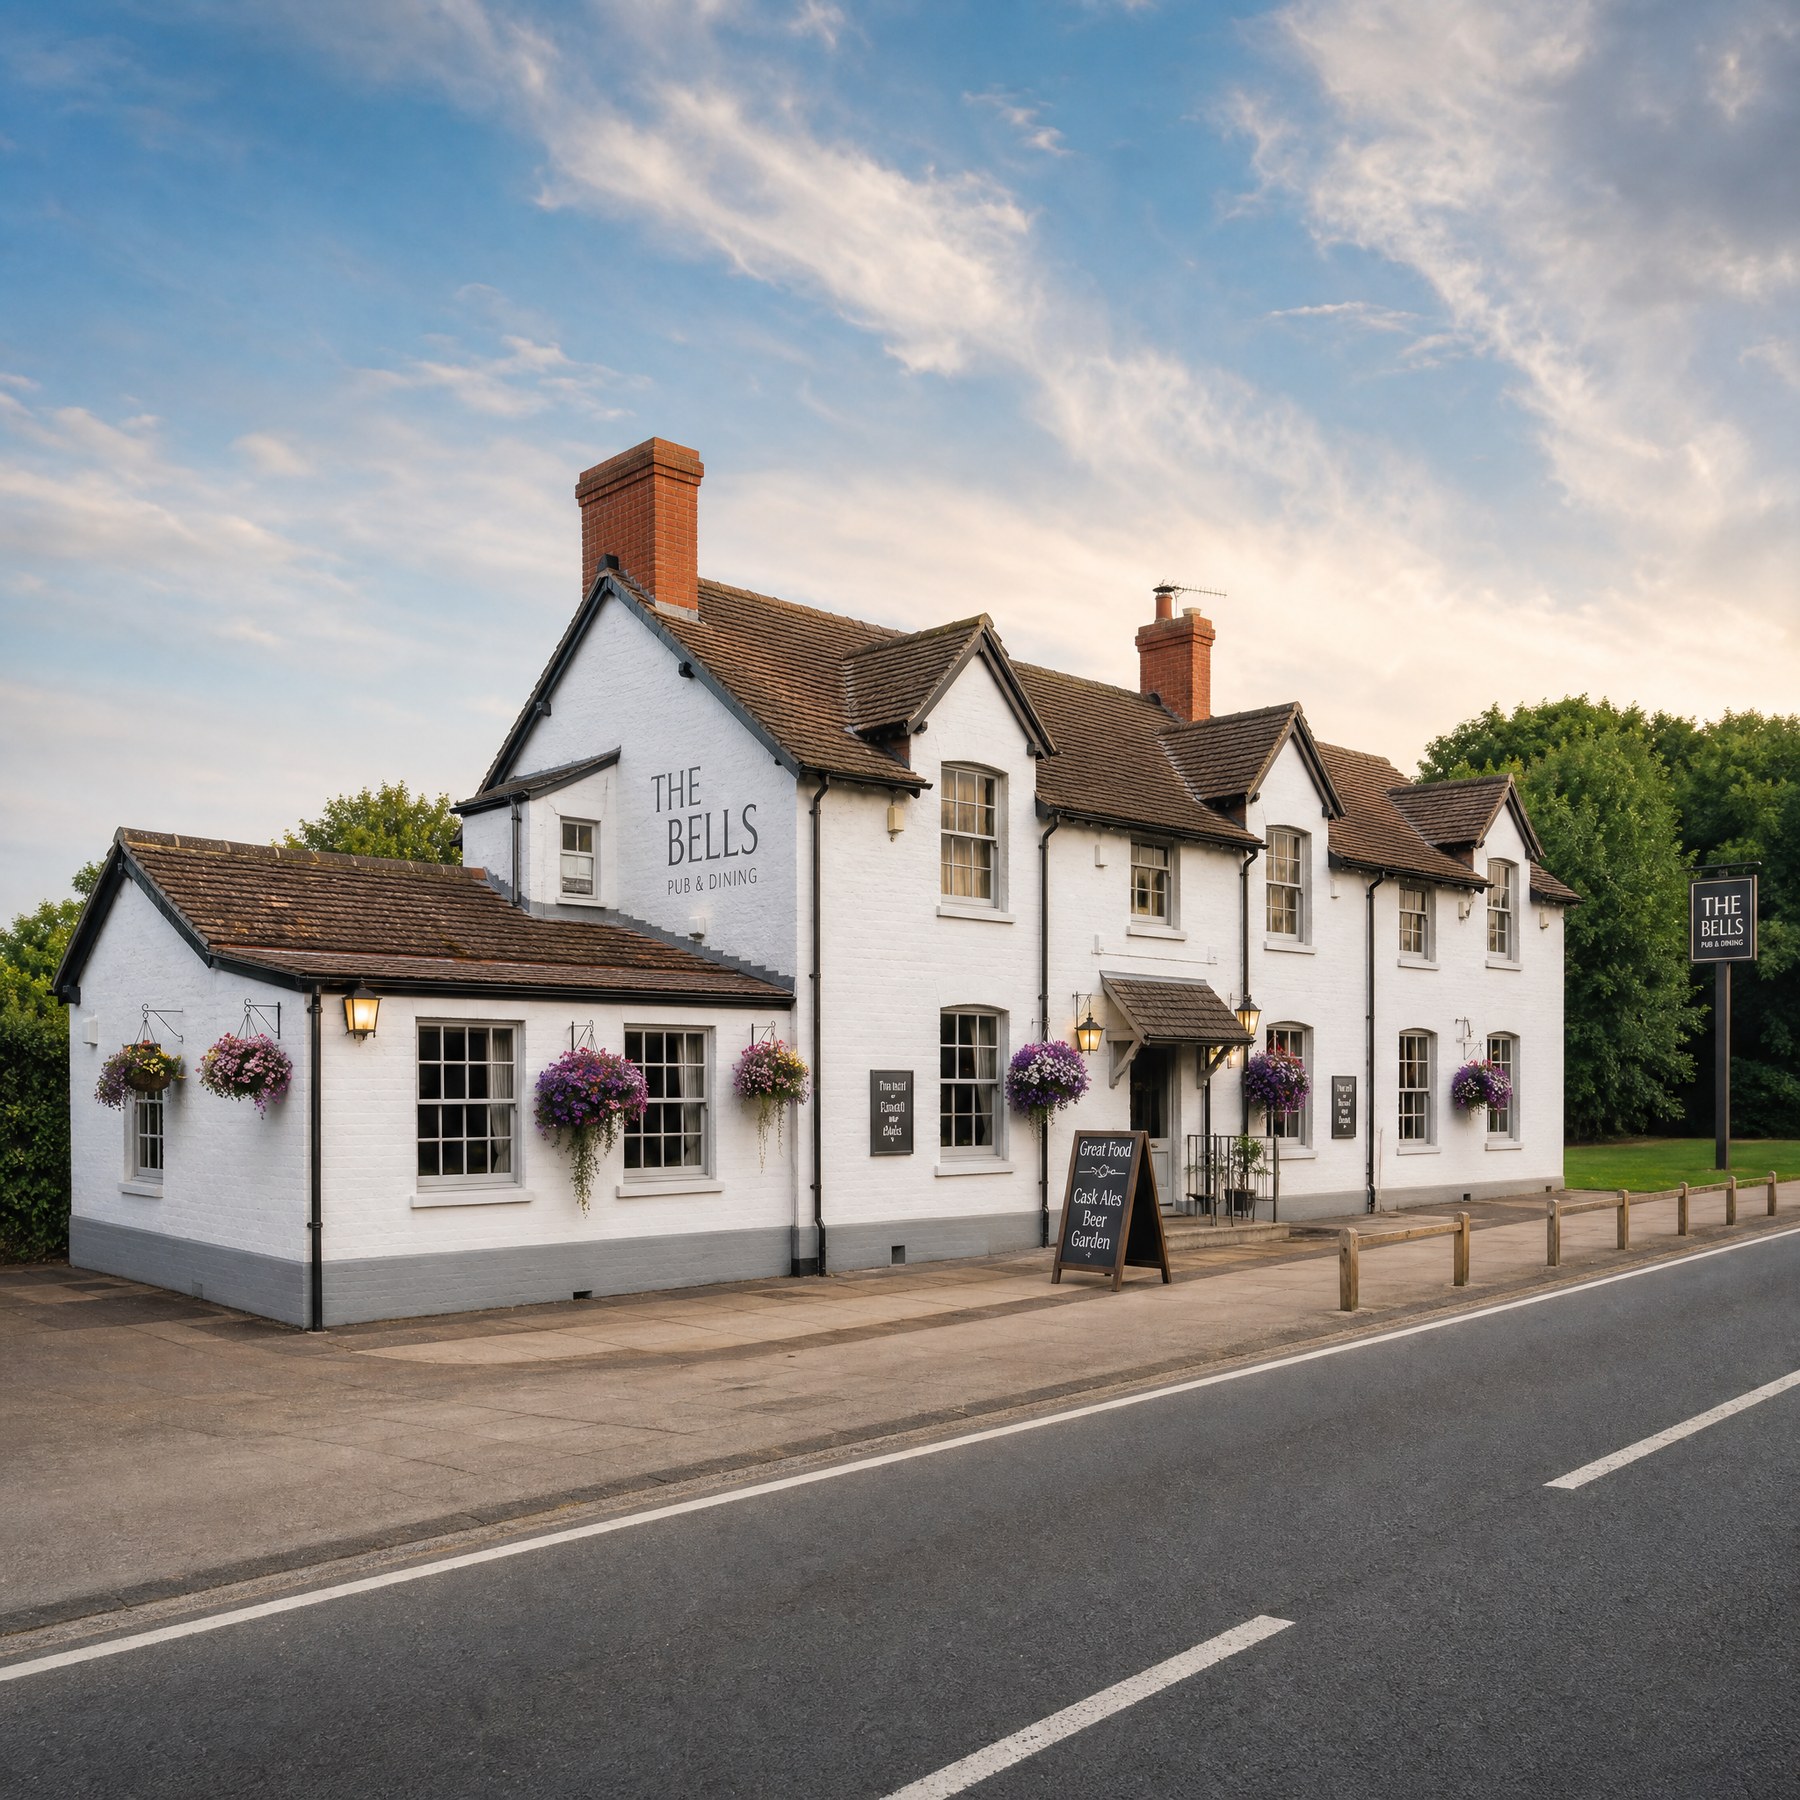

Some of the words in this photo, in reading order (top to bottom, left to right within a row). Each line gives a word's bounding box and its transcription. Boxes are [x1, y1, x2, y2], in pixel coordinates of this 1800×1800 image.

[651, 766, 702, 813] THE
[668, 803, 758, 866] BELLS
[668, 877, 691, 895] PUB
[695, 875, 704, 892] &
[709, 867, 757, 890] DINING
[1701, 894, 1741, 916] THE
[1701, 918, 1744, 937] BELLS
[1080, 1140, 1106, 1157] Great
[1107, 1141, 1133, 1158] Food
[1073, 1187, 1098, 1205] Cask
[1099, 1189, 1123, 1207] Ales
[1082, 1210, 1108, 1228] Beer
[1071, 1230, 1111, 1250] Garden
